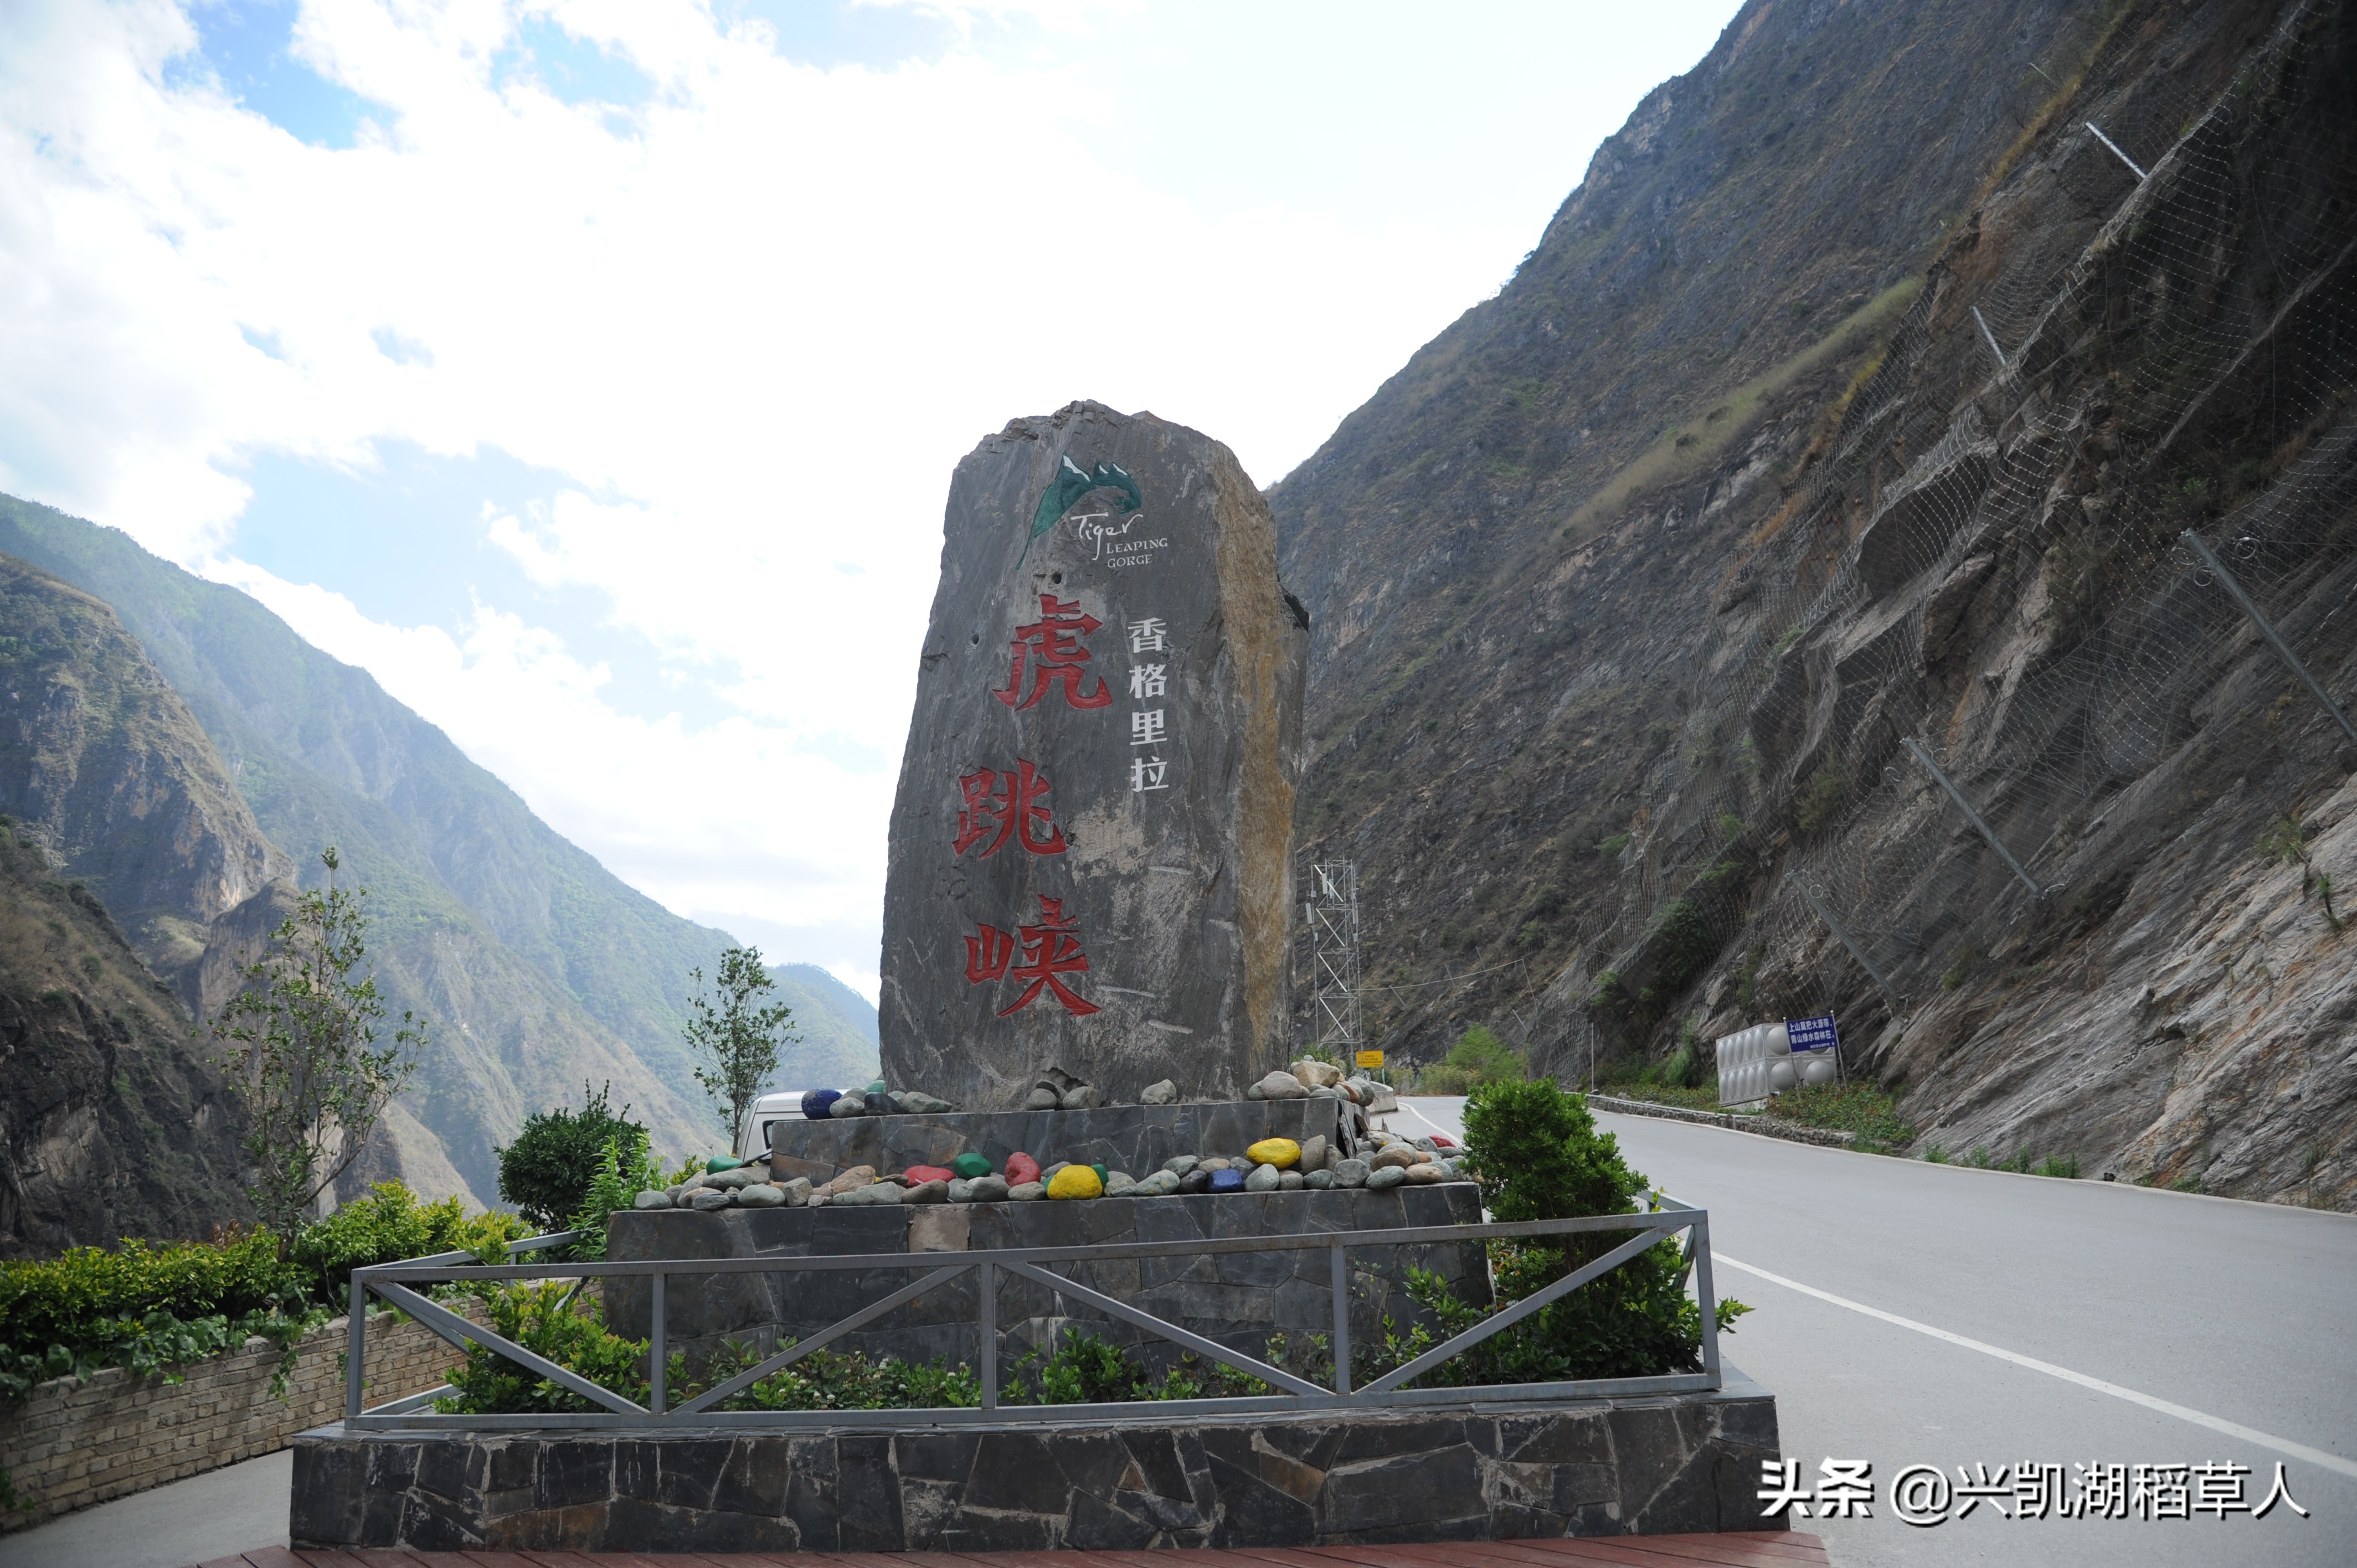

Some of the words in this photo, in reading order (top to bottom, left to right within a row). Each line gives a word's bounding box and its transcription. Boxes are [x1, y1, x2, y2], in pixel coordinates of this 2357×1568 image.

[1071, 512, 1143, 561] Tiger
[1106, 538, 1168, 554] LEAPING
[1107, 554, 1153, 568] GORGE
[1128, 616, 1170, 793] 香格里拉
